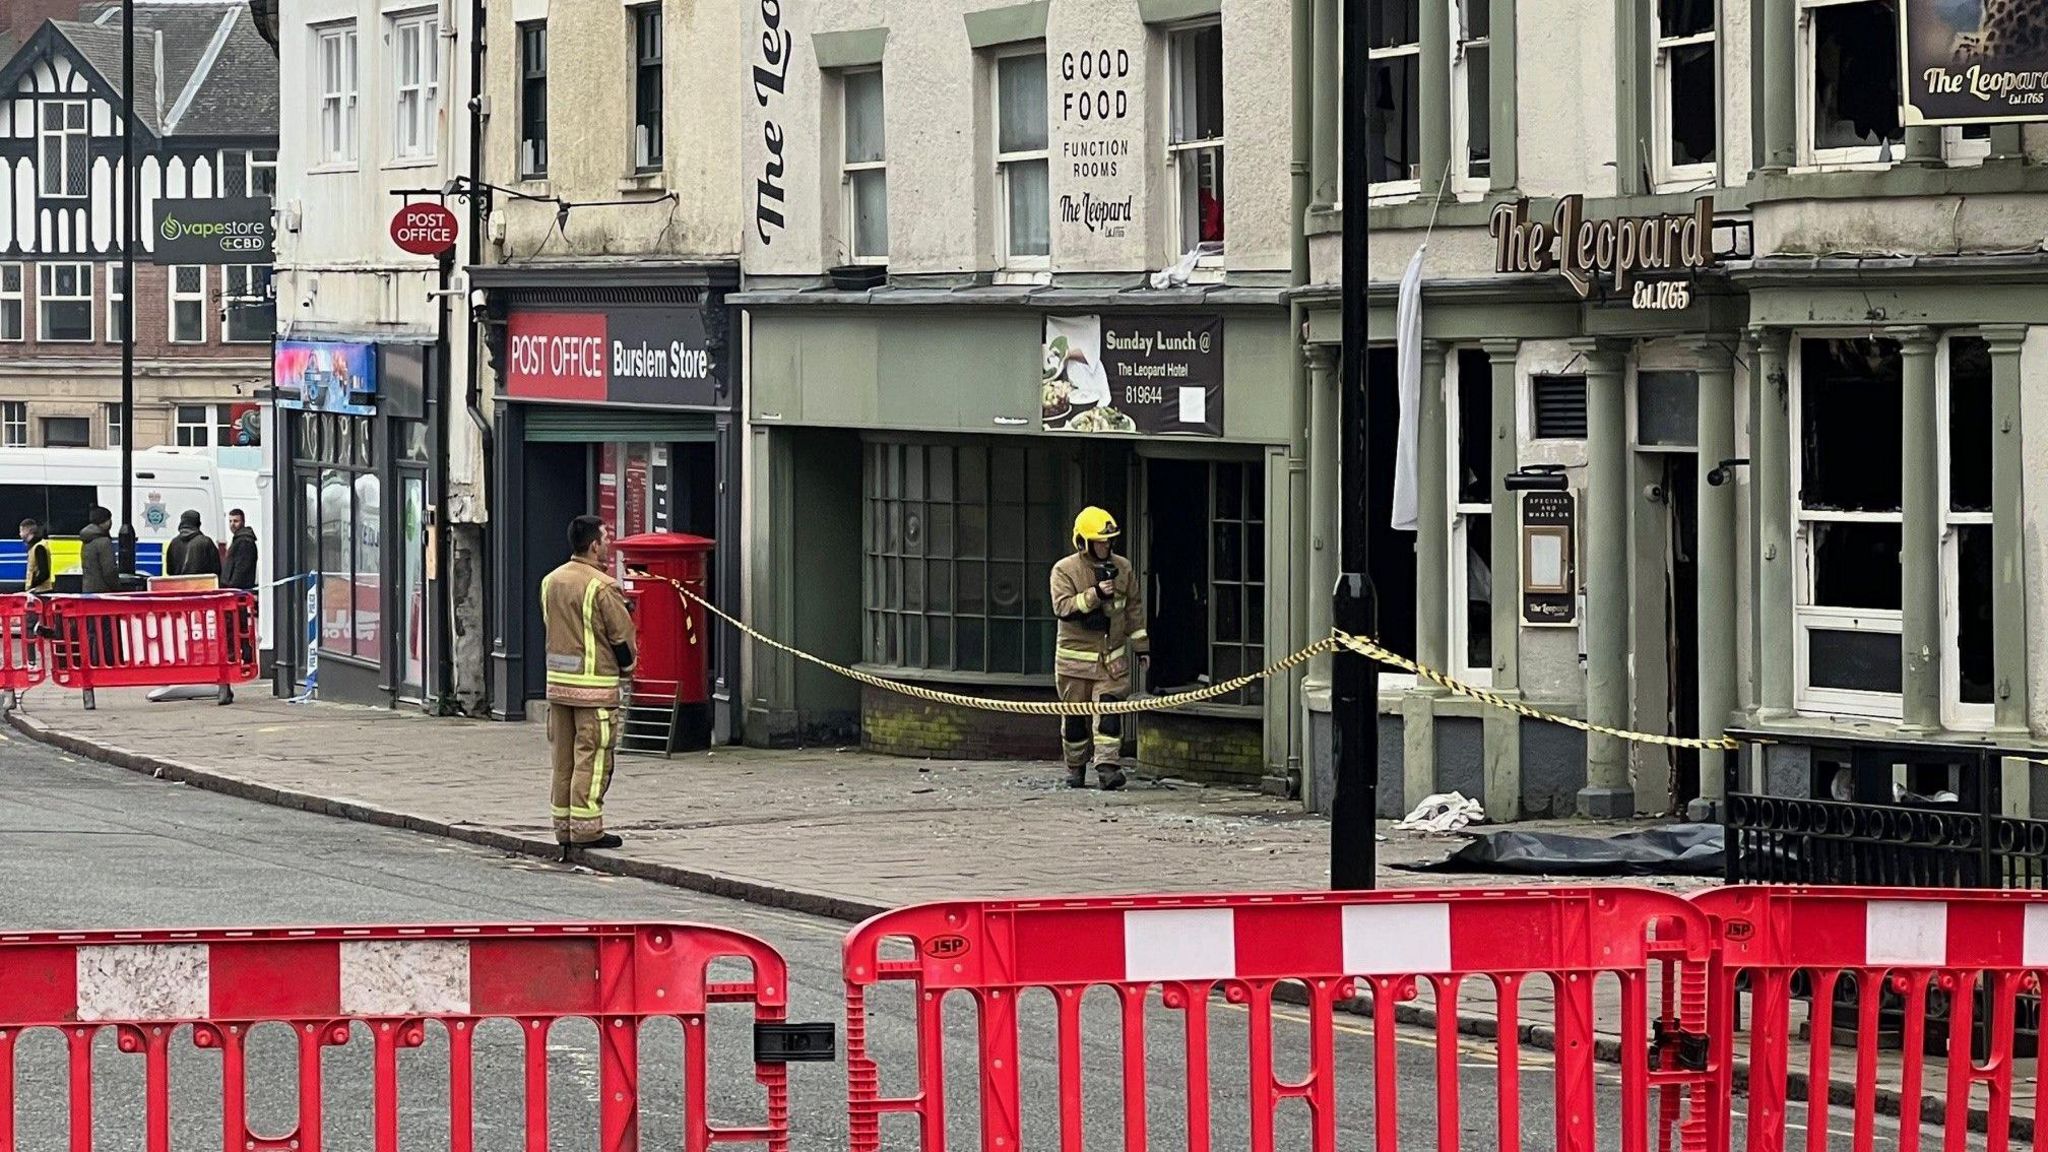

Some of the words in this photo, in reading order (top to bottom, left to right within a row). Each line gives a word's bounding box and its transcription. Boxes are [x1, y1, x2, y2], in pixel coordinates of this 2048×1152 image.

[1062, 49, 1129, 80] GOOD
[1923, 67, 1963, 93] The
[1064, 90, 1126, 121] FOOD
[1063, 140, 1128, 157] FUNCTION
[757, 120, 785, 245] The
[1074, 162, 1117, 177] ROOMS
[407, 213, 446, 227] POST
[1060, 195, 1080, 222] The
[1082, 192, 1132, 232] Leopard
[181, 221, 265, 238] vapestore
[397, 228, 451, 242] OFFICE
[1489, 200, 1547, 273] The
[1553, 194, 1714, 298] Leopard
[1632, 280, 1689, 310] Est.1765
[511, 335, 548, 376] POST
[550, 335, 602, 378] OFFICE
[1106, 330, 1154, 357] Sunday
[1157, 331, 1197, 350] Lunch
[1199, 331, 1211, 354] @
[613, 339, 668, 378] Burslem
[669, 339, 708, 379] Store
[1118, 362, 1132, 377] The
[1134, 363, 1166, 380] Leopard
[1168, 363, 1189, 377] Hotel
[1126, 386, 1163, 404] 819644
[930, 938, 964, 953] JSP
